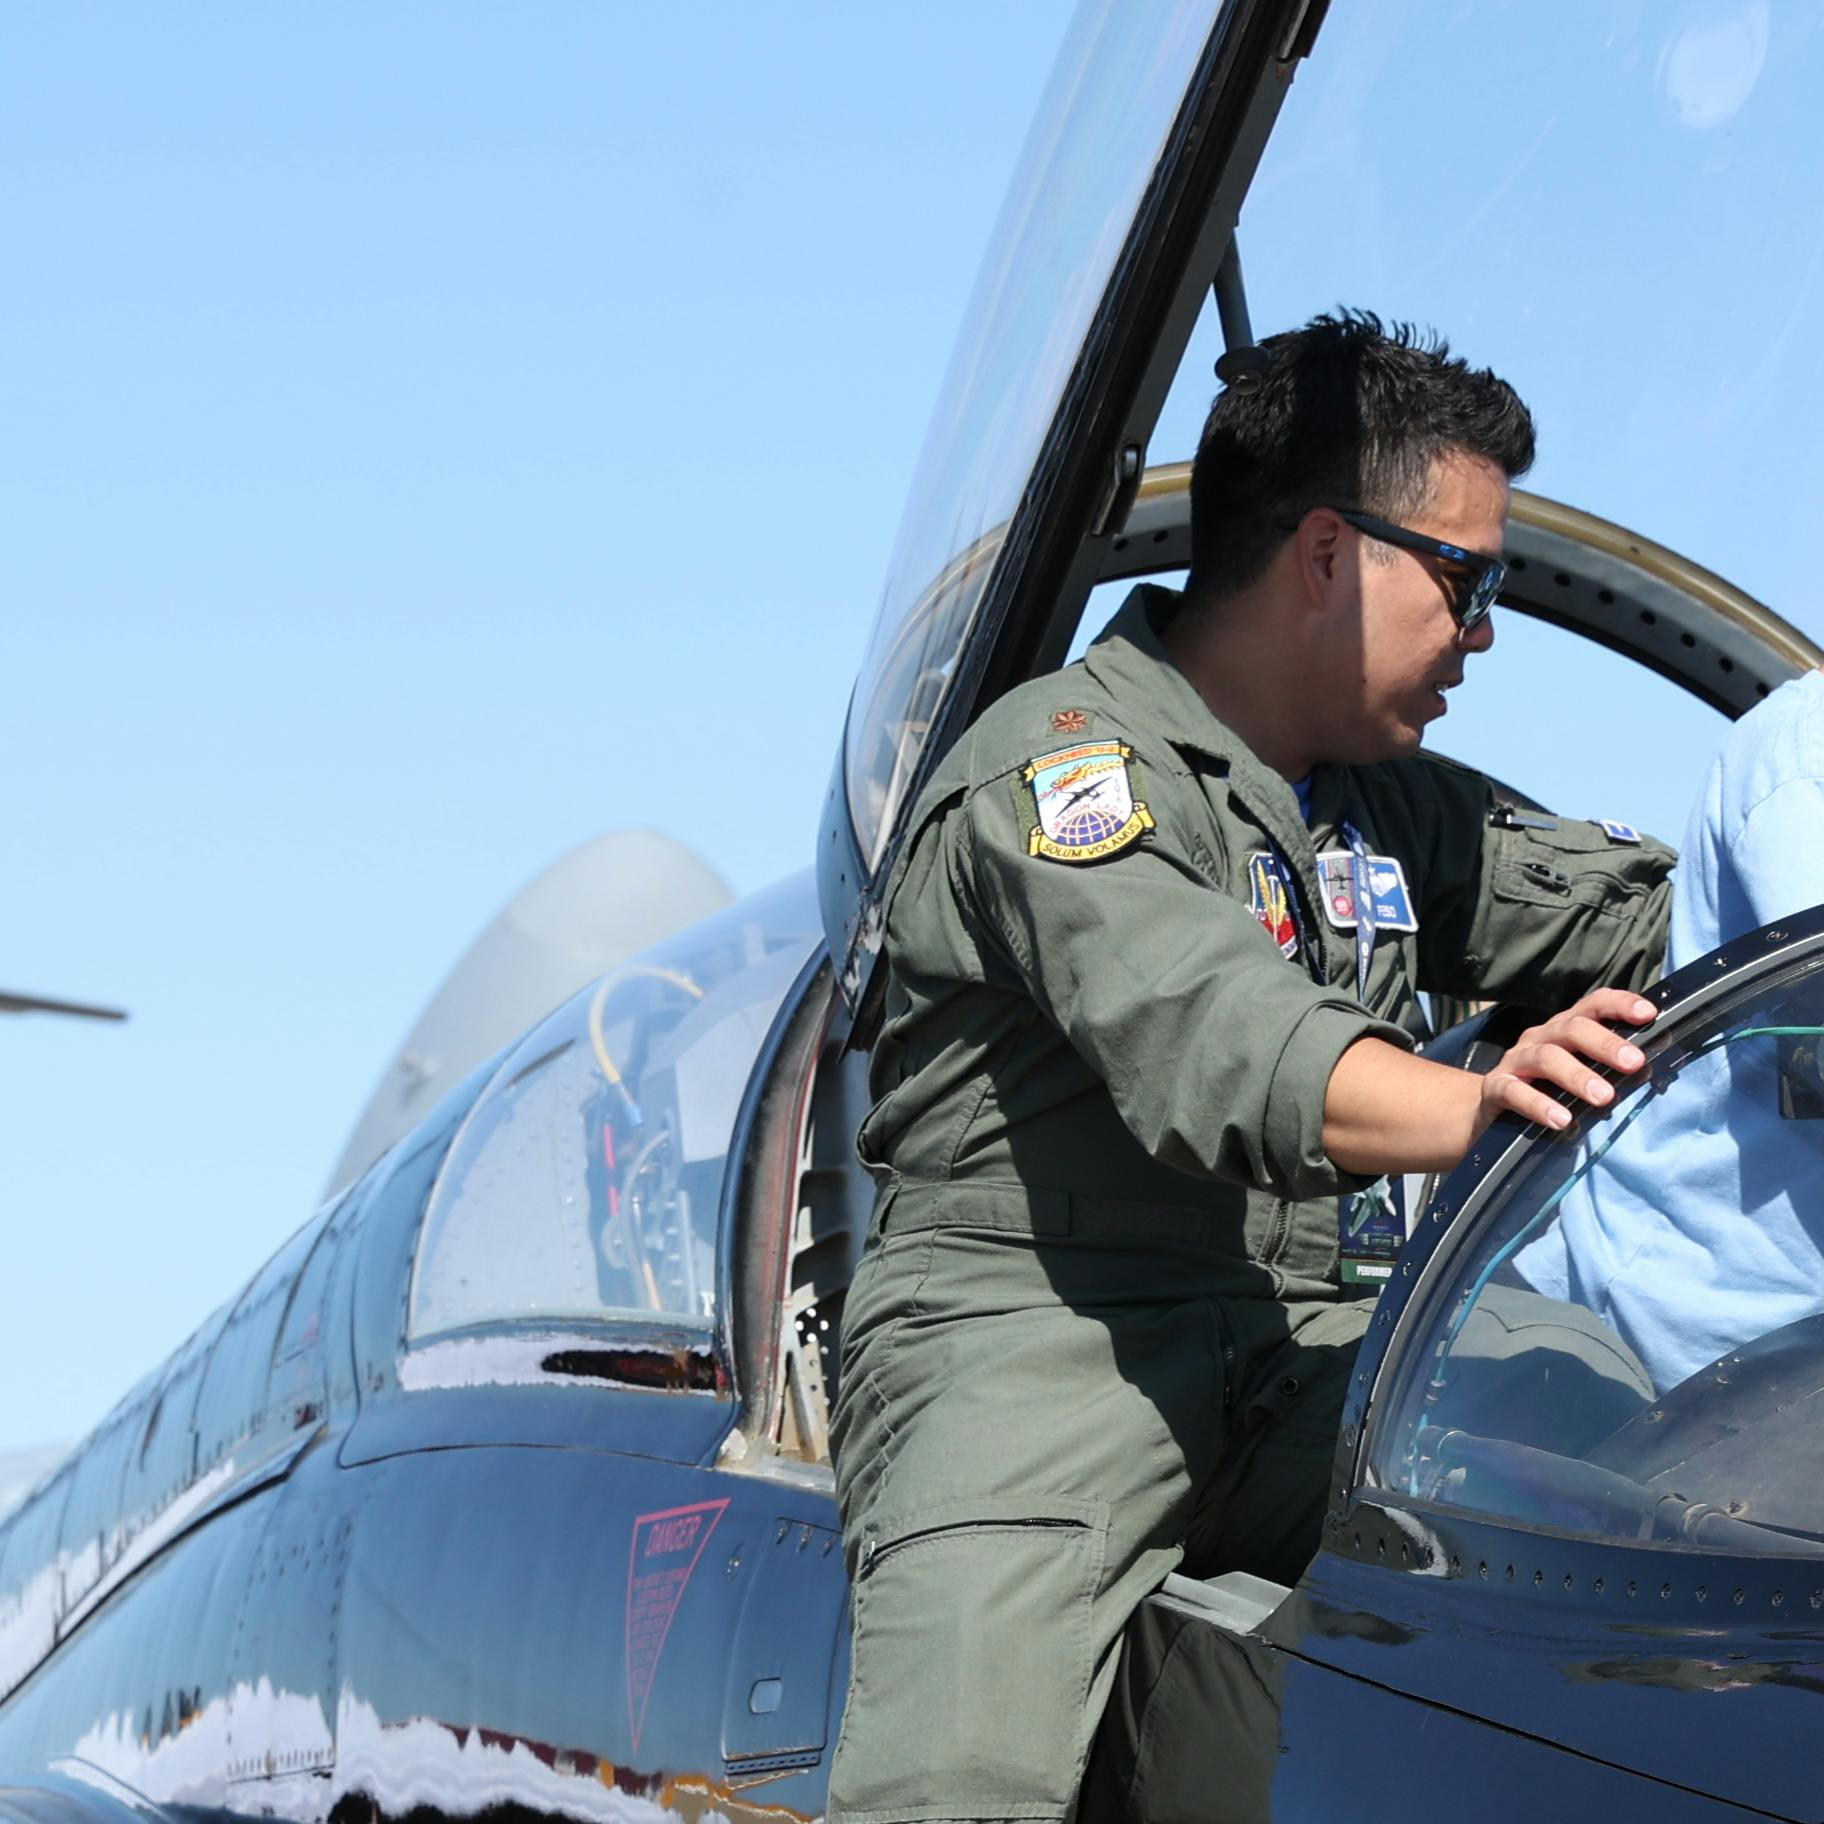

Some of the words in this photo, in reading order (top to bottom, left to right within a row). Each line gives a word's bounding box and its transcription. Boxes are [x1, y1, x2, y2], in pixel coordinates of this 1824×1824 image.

[1037, 747, 1092, 768] LOCKHEED
[1050, 803, 1090, 834] DRAGON
[1042, 842, 1082, 858] SOLUM
[1087, 822, 1141, 856] VOLAMUS
[644, 1515, 703, 1558] DANGER
